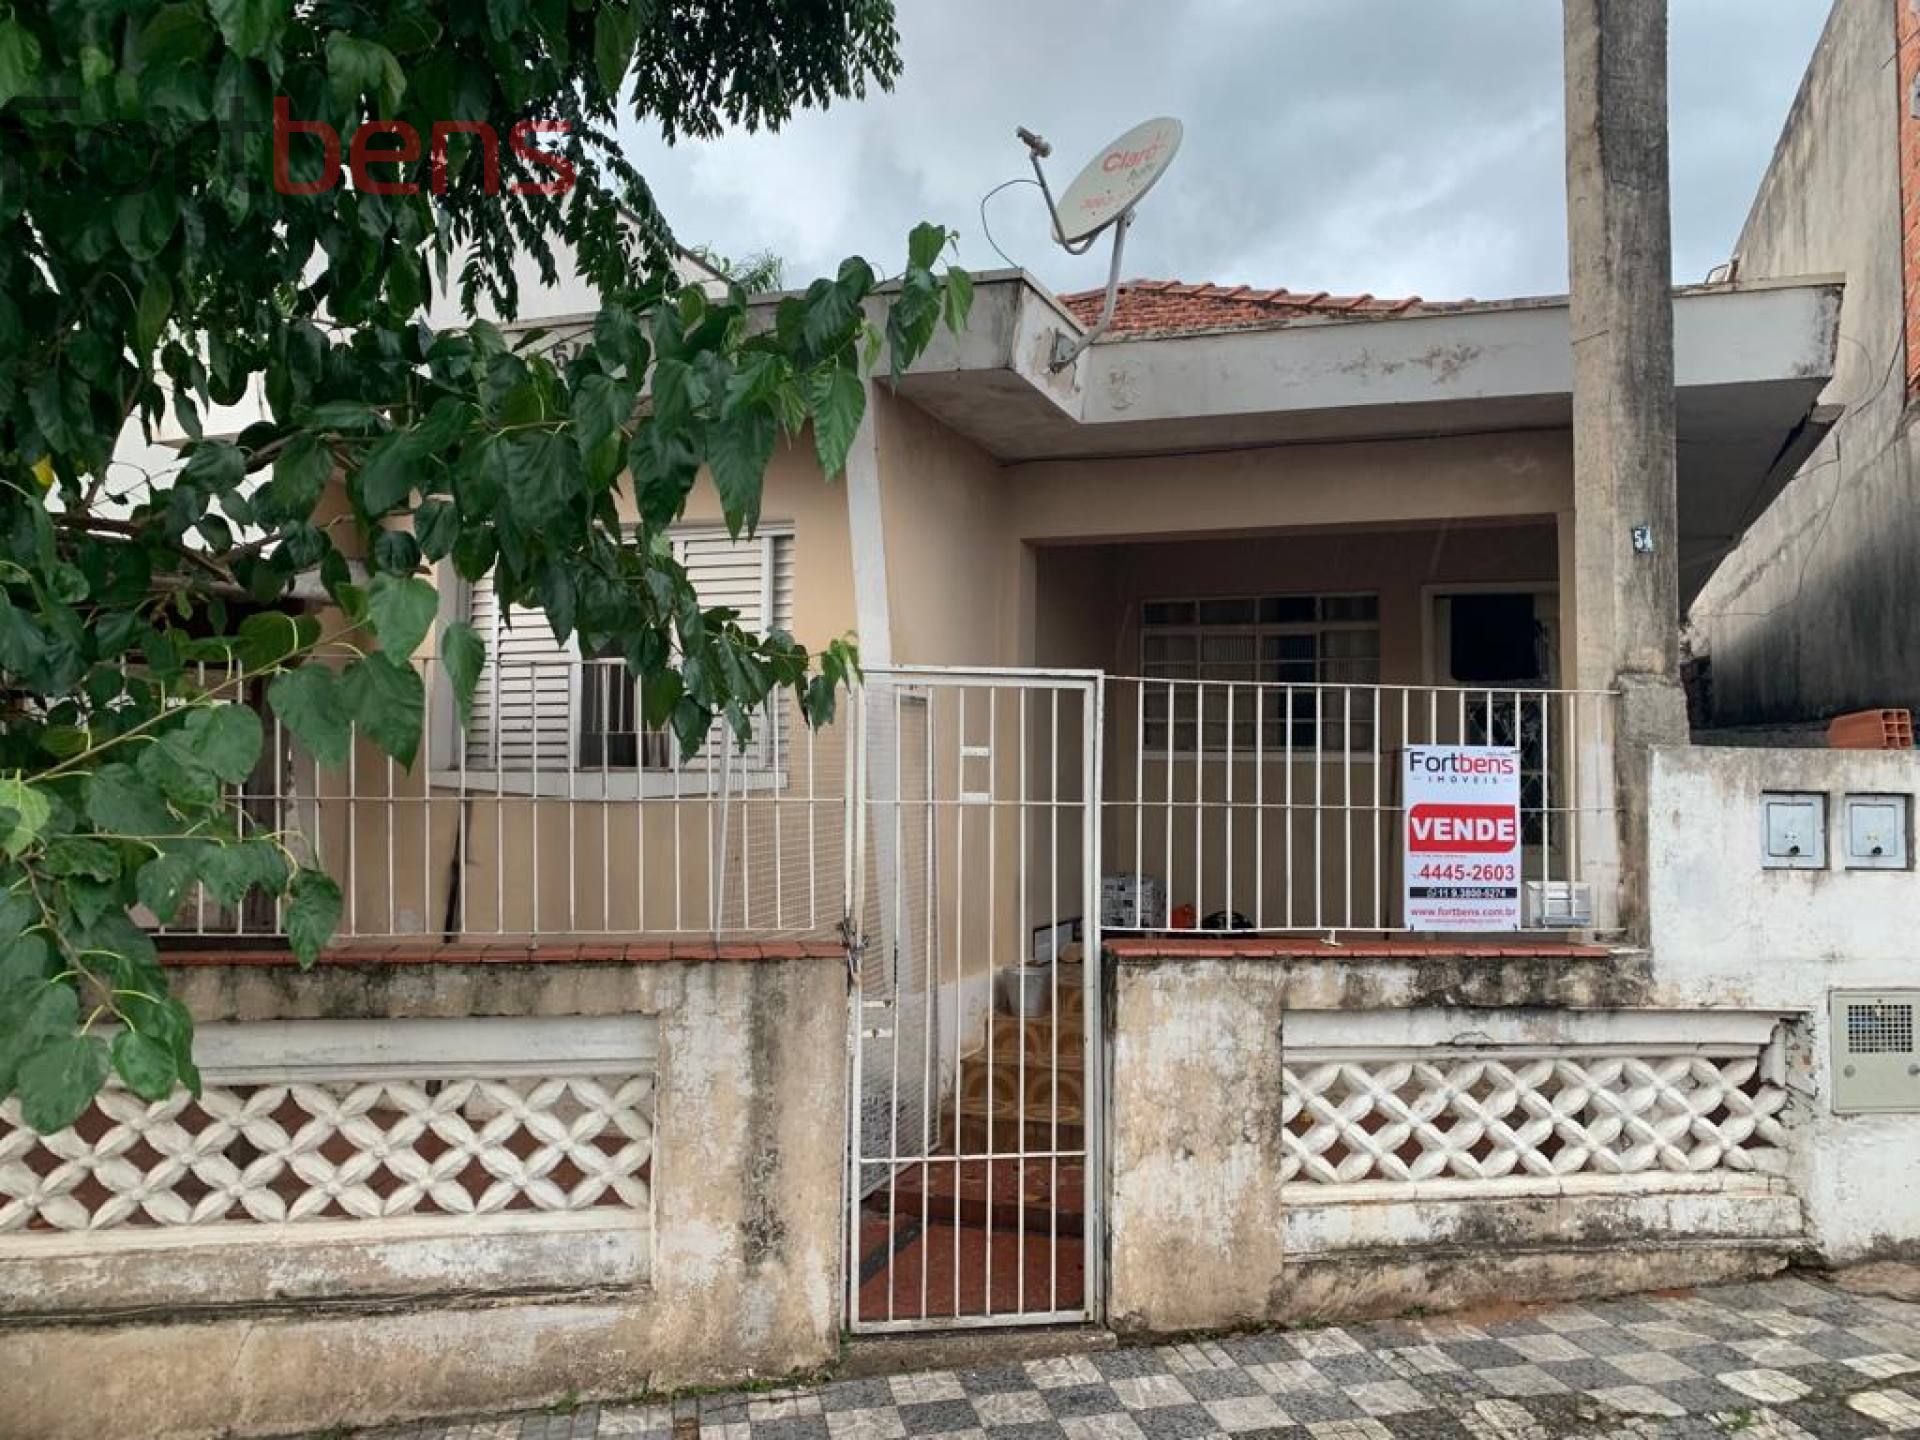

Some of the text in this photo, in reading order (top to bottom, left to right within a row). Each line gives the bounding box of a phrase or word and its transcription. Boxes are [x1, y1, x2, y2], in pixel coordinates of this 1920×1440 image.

[1410, 752, 1514, 774] Fortbens
[1411, 817, 1515, 841] VENDE
[1420, 864, 1515, 881] 4445-2603
[1411, 906, 1516, 916] www.fortbens.com.br
